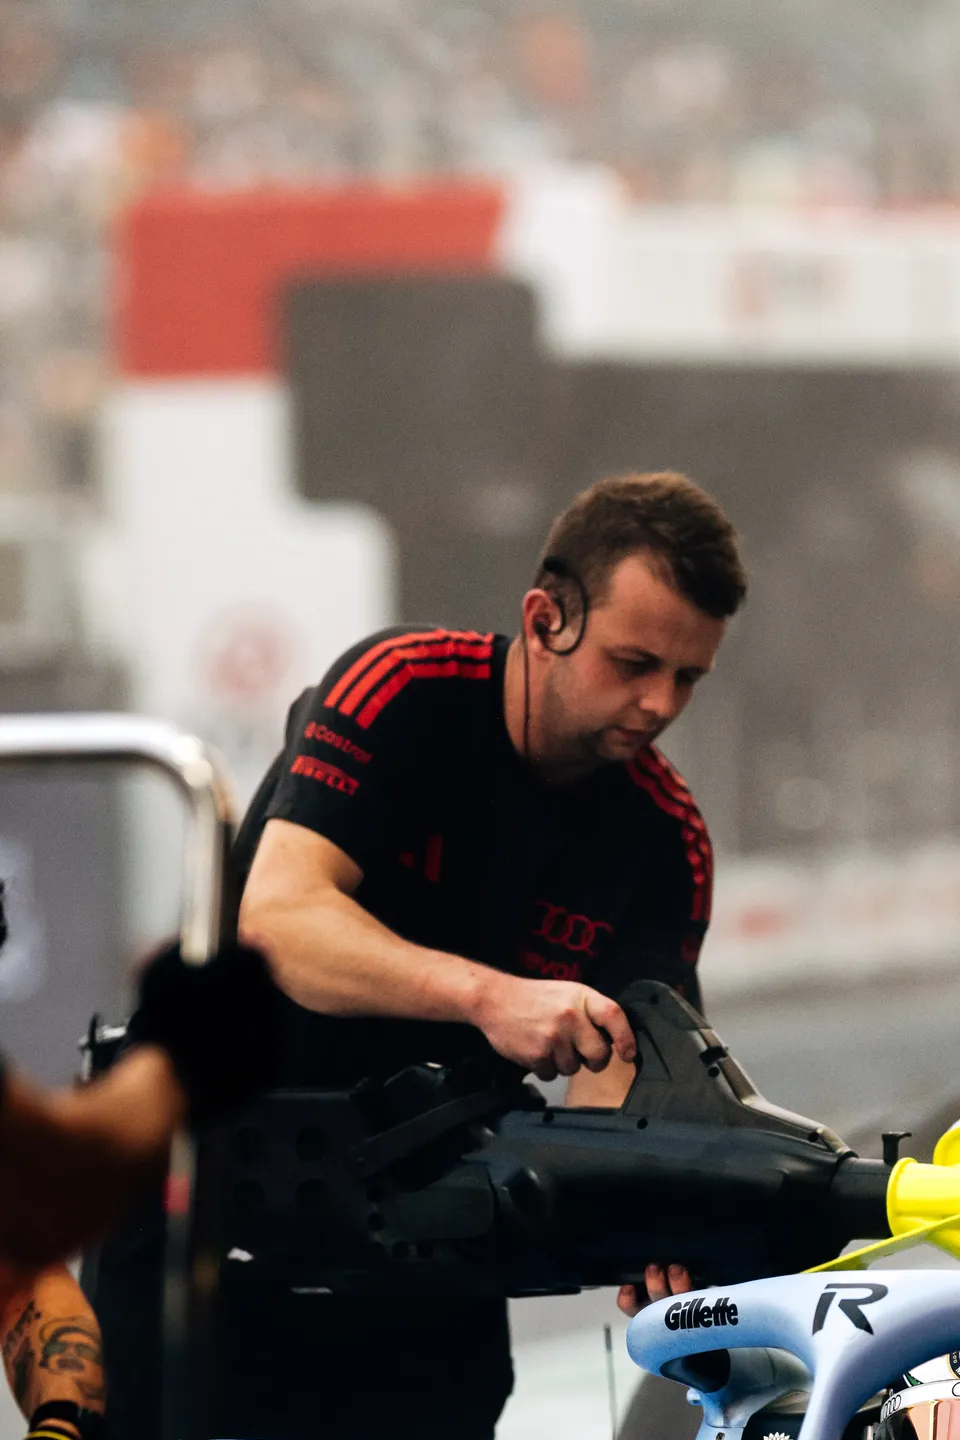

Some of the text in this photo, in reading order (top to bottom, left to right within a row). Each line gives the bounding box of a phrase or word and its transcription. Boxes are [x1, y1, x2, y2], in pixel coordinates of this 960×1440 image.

[315, 724, 373, 764] Castrol
[290, 755, 360, 797] PIRELLI
[664, 1297, 739, 1331] Gillette
